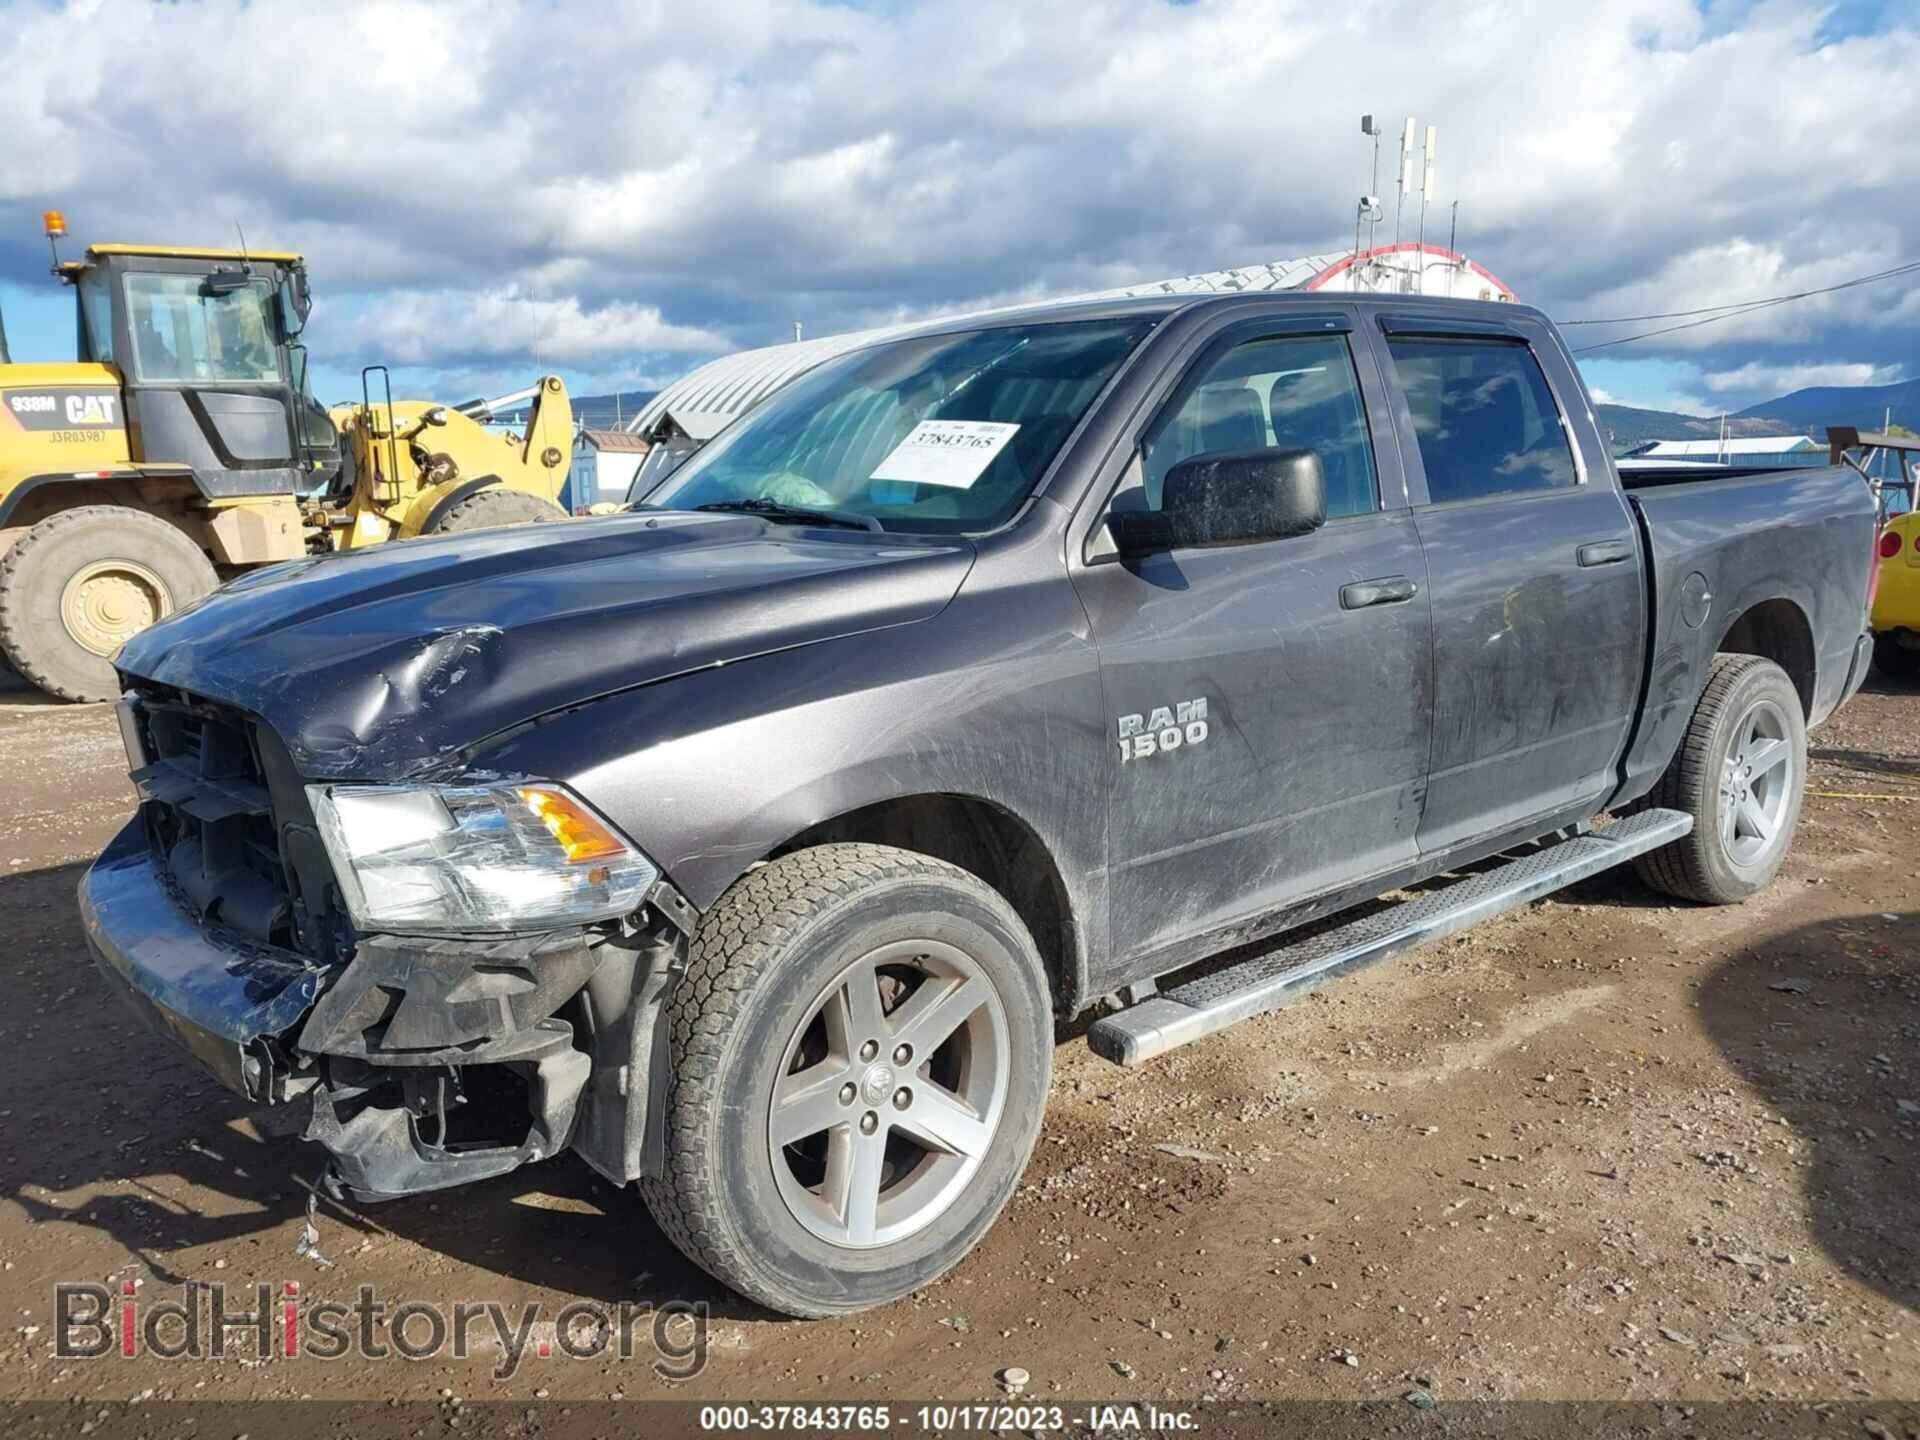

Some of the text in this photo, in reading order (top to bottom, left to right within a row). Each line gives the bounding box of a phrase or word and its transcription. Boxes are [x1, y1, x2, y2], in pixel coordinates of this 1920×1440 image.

[10, 395, 115, 424] 938M CAT
[912, 432, 996, 448] 37843765
[1118, 697, 1208, 738] RAM
[1119, 720, 1208, 766] 1500
